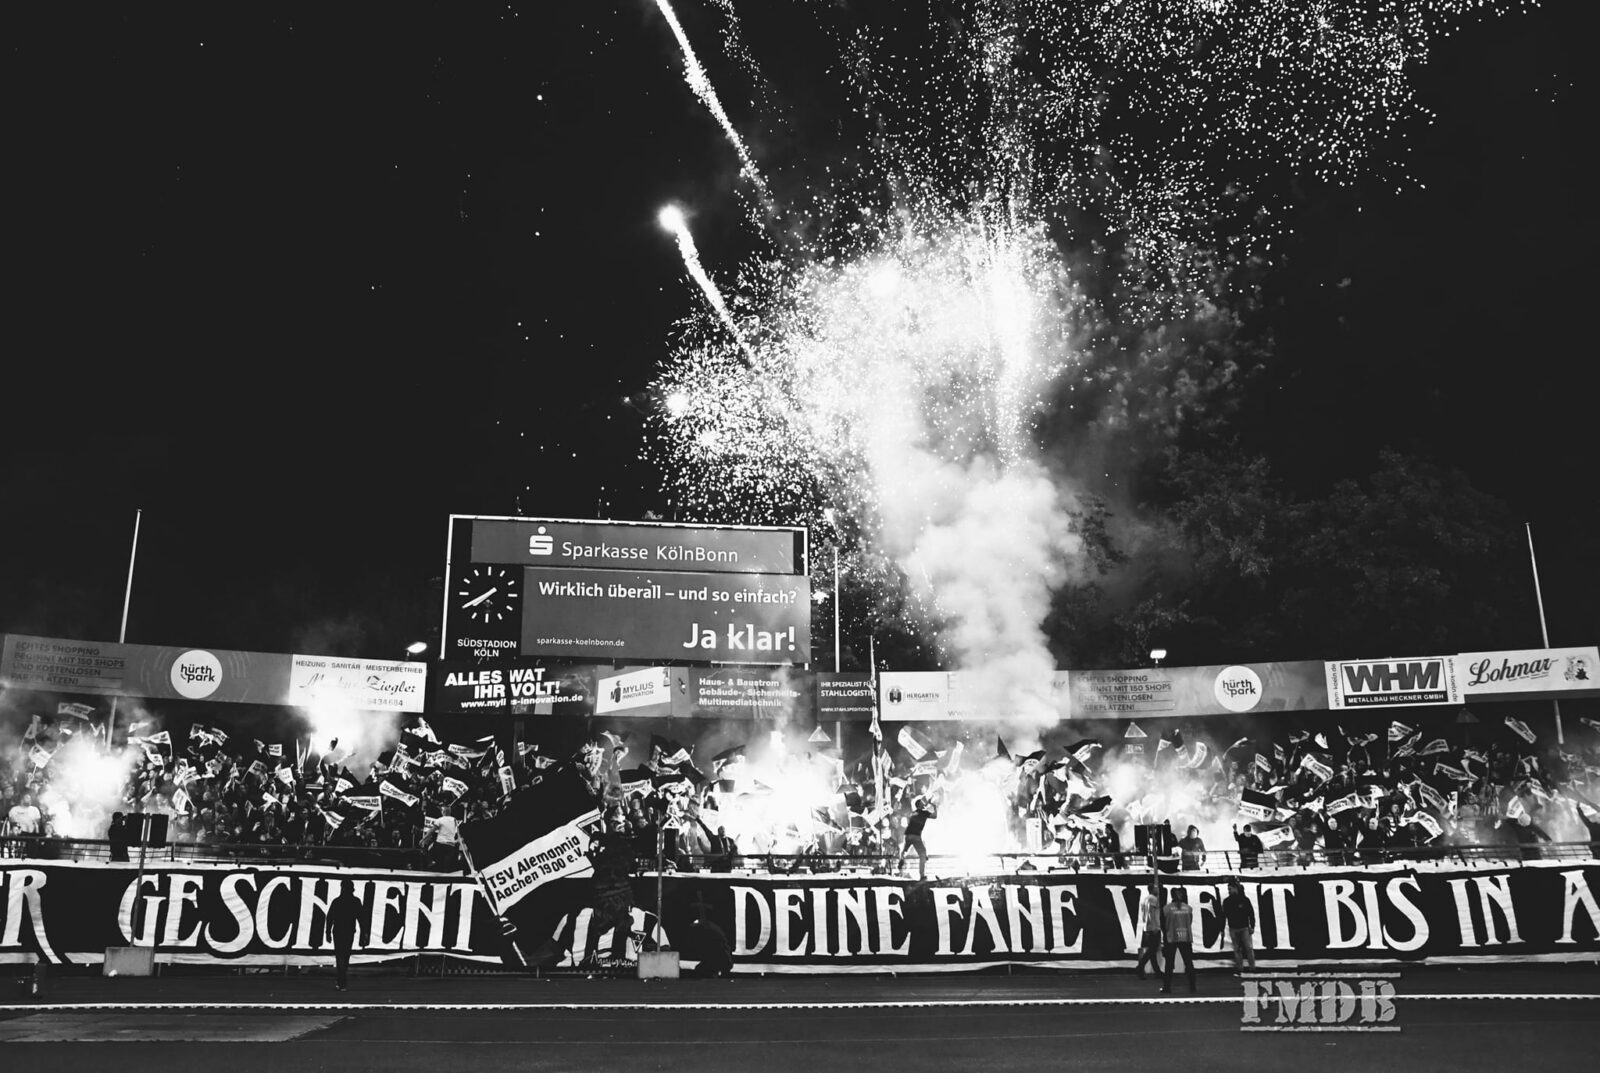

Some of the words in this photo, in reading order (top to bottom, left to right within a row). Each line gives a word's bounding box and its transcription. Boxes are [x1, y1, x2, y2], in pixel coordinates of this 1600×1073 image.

[562, 541, 648, 562] Sparkasse
[656, 545, 738, 562] KölnBonn
[539, 581, 603, 597] Wirklich
[608, 584, 661, 599] überall
[679, 588, 707, 600] und
[712, 591, 729, 601] so
[734, 589, 797, 603] einfach?
[457, 637, 517, 648] SÜDSTADION
[537, 636, 625, 647] sparkasse-koelnbonn.de
[683, 623, 717, 649] Ja
[728, 623, 796, 651] klar!
[52, 645, 100, 656] SHOPPING
[474, 648, 499, 657] KÖLN
[58, 656, 75, 665] MIT
[95, 659, 124, 668] SHOPS
[296, 660, 326, 669] HEIZUNG
[366, 665, 423, 674] MEISTERBETRIEB
[37, 664, 101, 676] KOSTENLOSEN
[181, 664, 212, 675] hürth
[1468, 658, 1559, 686] Lohmar
[187, 674, 215, 683] park
[445, 670, 502, 686] ALLES
[509, 668, 546, 682] WAT
[699, 678, 725, 686] Haus-
[728, 678, 734, 686] &
[737, 678, 780, 687] Baustrom
[1107, 675, 1148, 683] SHOPPING
[1344, 661, 1440, 692] WHM
[366, 675, 416, 695] Ziegler
[474, 684, 505, 699] IHR
[511, 681, 560, 697] VOLT!
[623, 682, 654, 694] MYLIUS
[1145, 683, 1171, 691] SHOPS
[1223, 679, 1252, 689] hürth
[622, 690, 654, 700] INNOVATION
[747, 688, 801, 698] Sicherheits-
[1230, 688, 1256, 698] park
[1348, 696, 1388, 704] METALLBAU
[1390, 694, 1422, 702] HECKNER
[1424, 693, 1444, 701] GMBH
[699, 698, 782, 707] Multimediatechnik
[487, 867, 514, 889] TSV
[517, 835, 580, 875] Alemannia
[495, 871, 539, 902] Aachen
[538, 858, 566, 875] 1900
[0, 869, 62, 964] R
[1319, 874, 1429, 951] BIS
[1447, 874, 1526, 947] IN
[730, 885, 911, 956] DEINE
